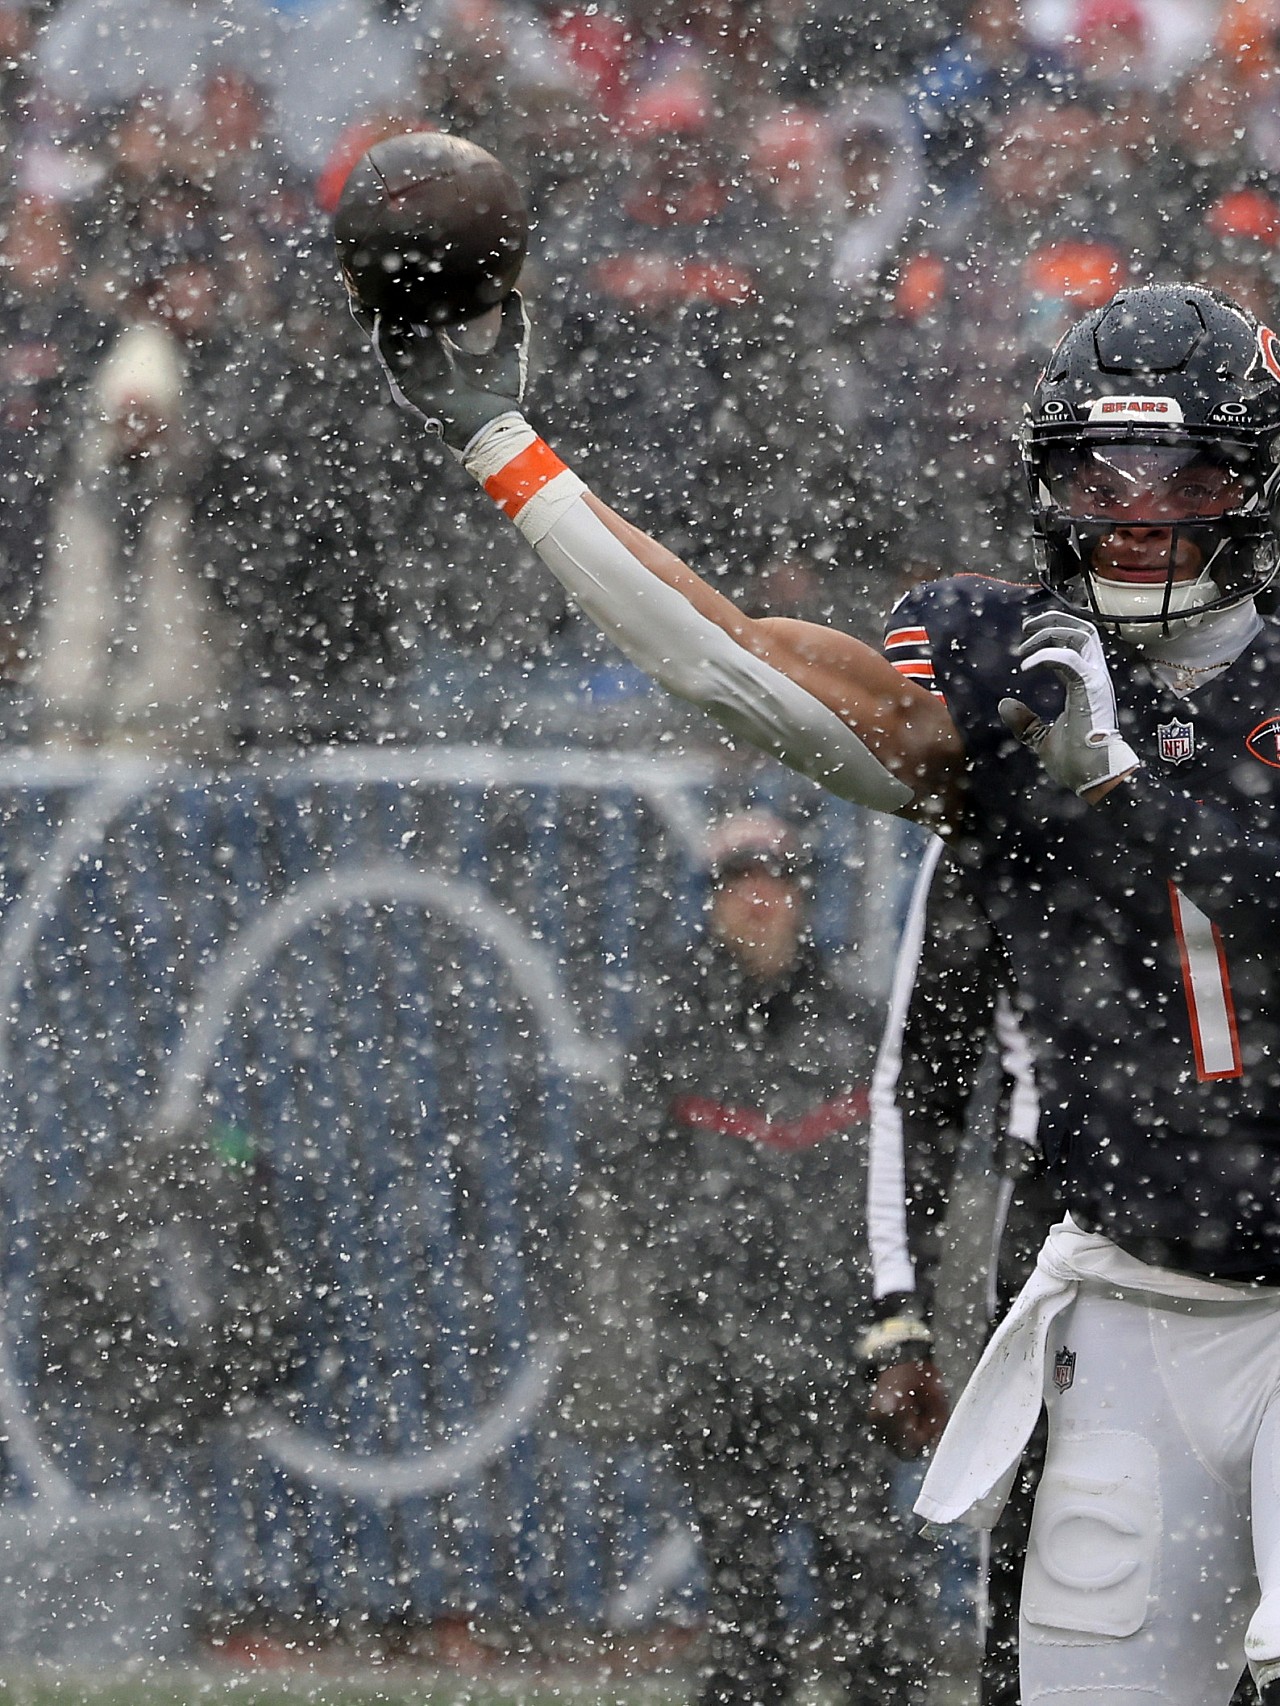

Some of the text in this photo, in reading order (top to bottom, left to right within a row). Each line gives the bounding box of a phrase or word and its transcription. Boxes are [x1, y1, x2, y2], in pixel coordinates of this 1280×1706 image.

[1102, 402, 1169, 413] BEARS
[1213, 414, 1252, 423] OAKLEY
[1163, 738, 1190, 759] NFL
[1167, 879, 1244, 1082] 1
